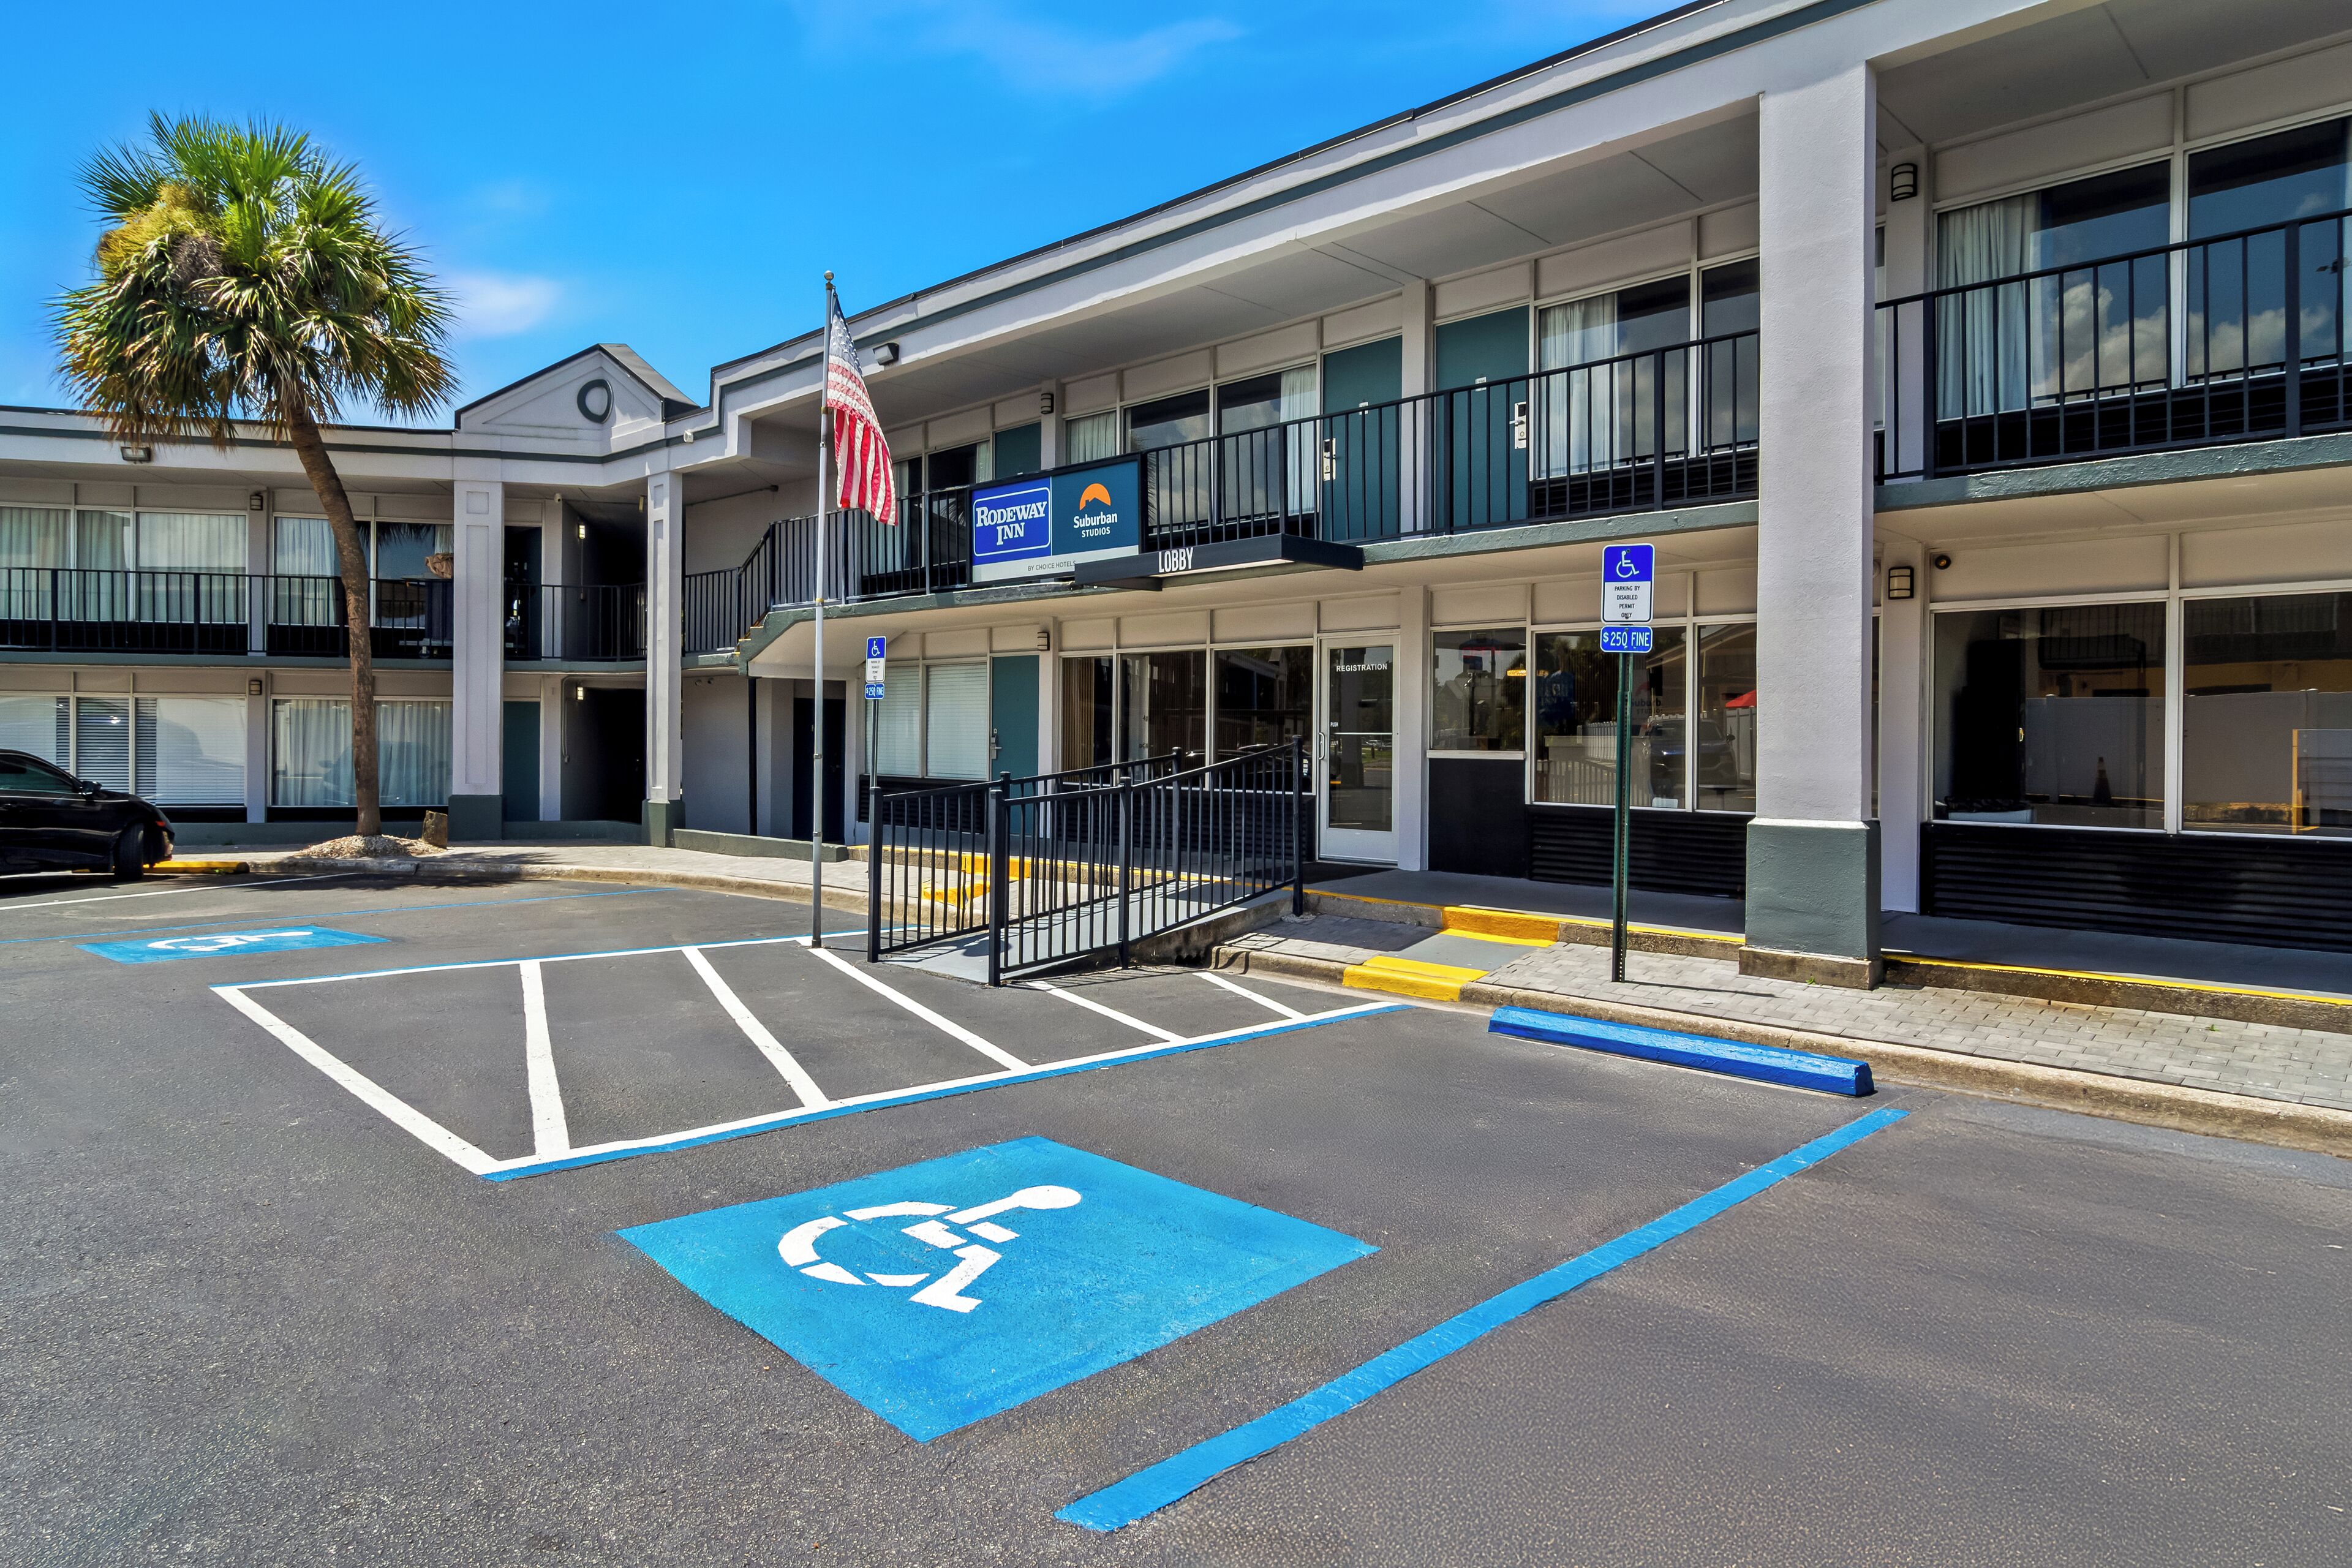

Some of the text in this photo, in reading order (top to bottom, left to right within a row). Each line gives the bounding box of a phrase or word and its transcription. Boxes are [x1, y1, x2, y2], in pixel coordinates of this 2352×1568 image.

[976, 501, 1047, 527] RODEWAY
[1073, 511, 1117, 529] Suburban
[997, 522, 1025, 546] INN
[1082, 527, 1110, 538] STUDIOS
[1158, 547, 1193, 573] LOBBY
[1631, 631, 1649, 646] FINE
[1336, 663, 1387, 672] REGISTRATION
